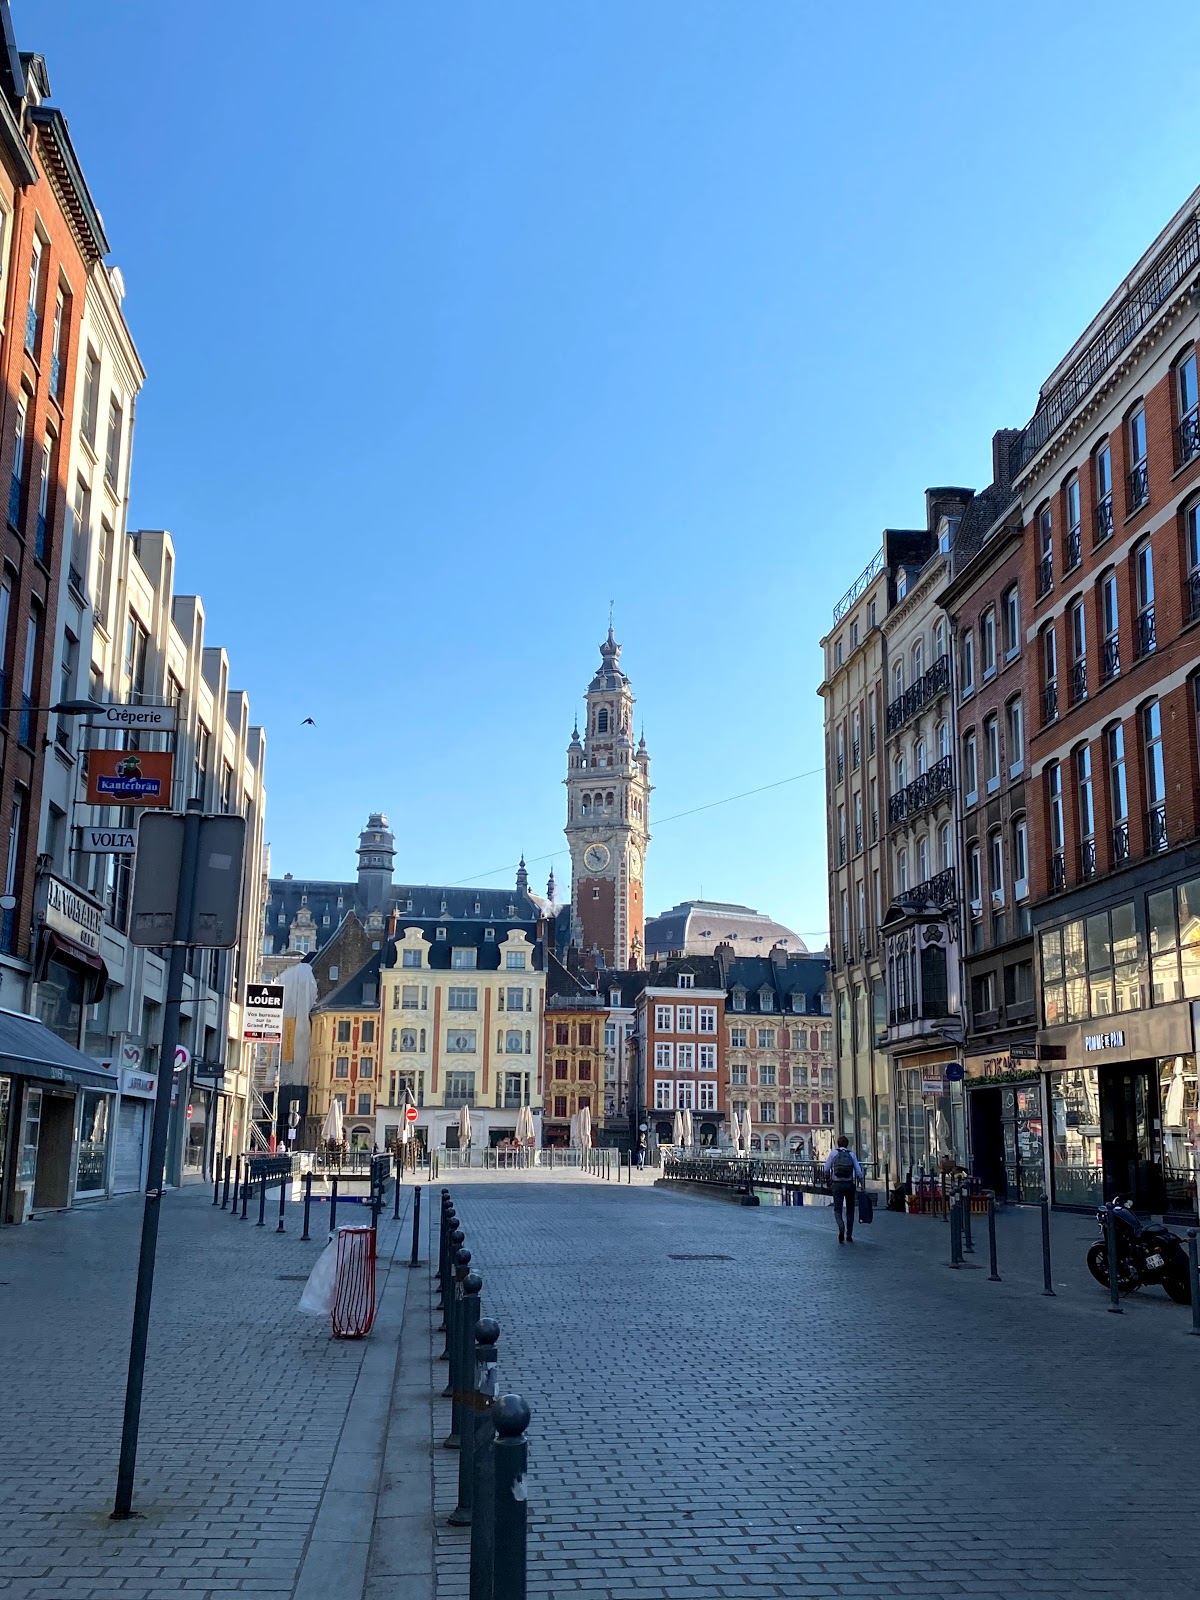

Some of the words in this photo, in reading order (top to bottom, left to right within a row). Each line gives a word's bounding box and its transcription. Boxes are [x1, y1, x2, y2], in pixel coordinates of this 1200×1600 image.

[107, 707, 161, 724] Crêperie
[101, 780, 158, 791] Kanterbräu
[91, 832, 135, 847] VOLTA
[48, 881, 60, 911] LE
[63, 890, 101, 935] VOLTAIRE
[262, 988, 268, 996] A
[248, 996, 280, 1006] LOUER
[1085, 1033, 1104, 1051] POMME
[1110, 1030, 1124, 1048] PAIN
